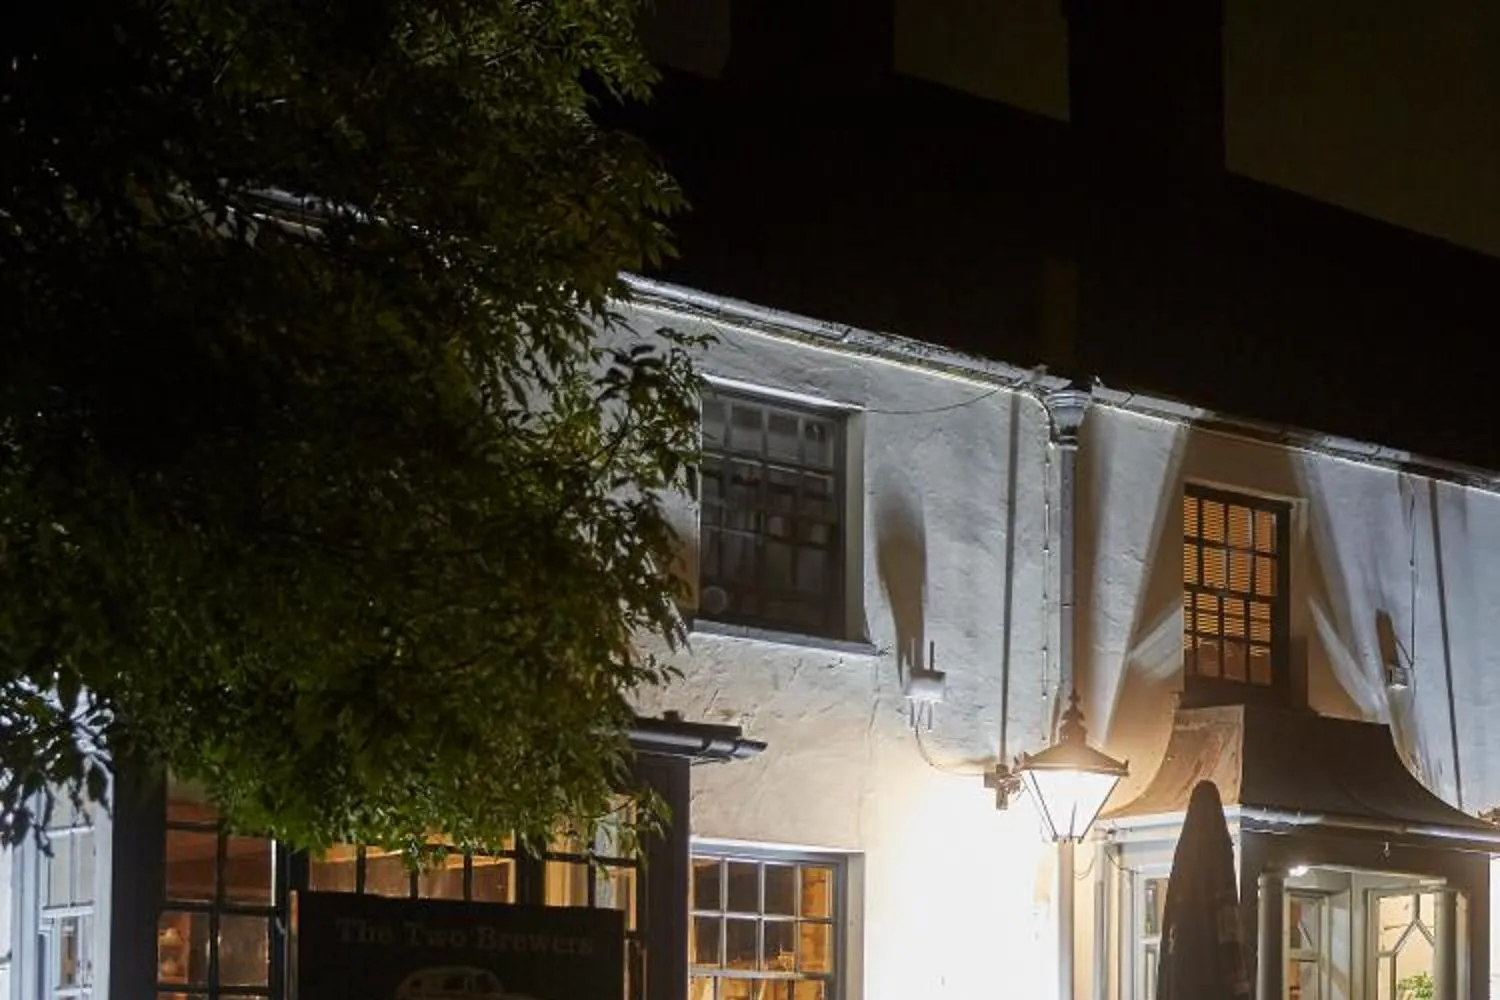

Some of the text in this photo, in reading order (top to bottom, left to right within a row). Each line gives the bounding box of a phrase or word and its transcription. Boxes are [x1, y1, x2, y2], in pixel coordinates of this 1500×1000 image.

[334, 918, 592, 954] The Two Brewers
